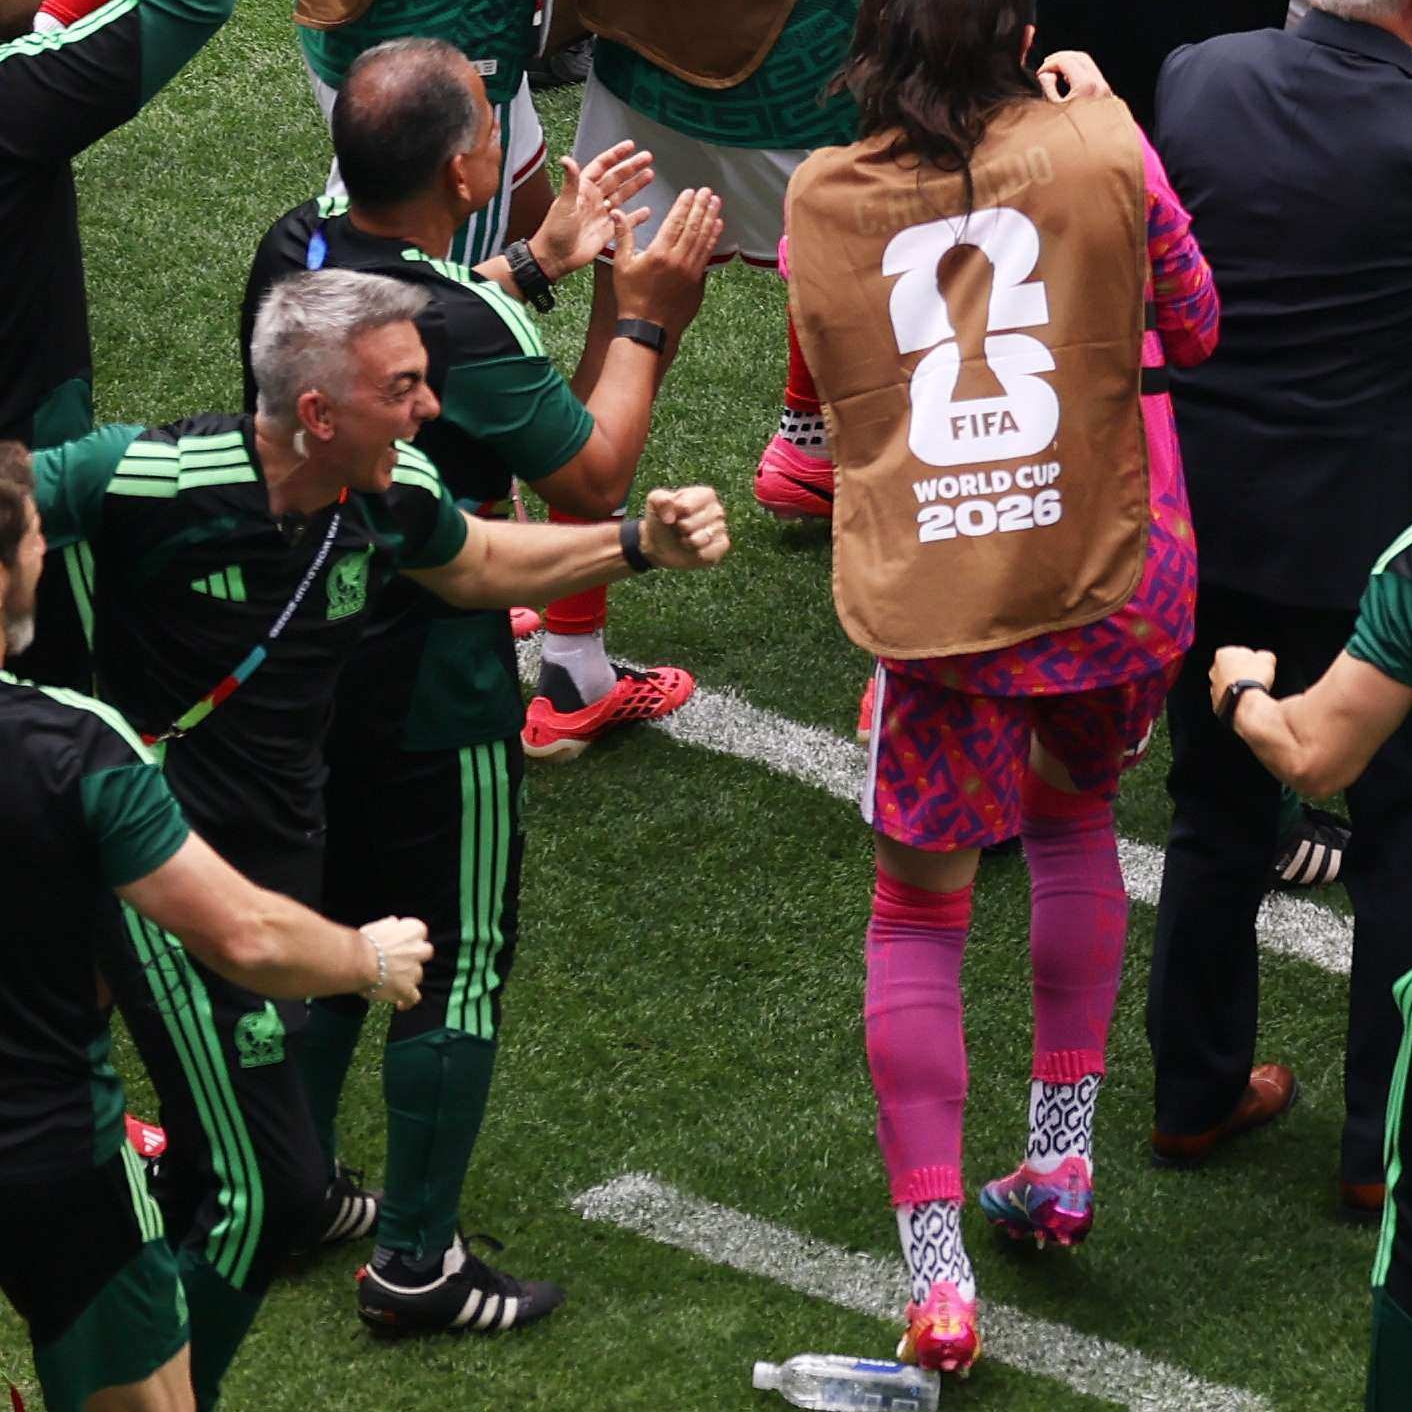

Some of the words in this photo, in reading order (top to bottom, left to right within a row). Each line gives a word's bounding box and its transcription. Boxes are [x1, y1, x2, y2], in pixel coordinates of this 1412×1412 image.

[950, 410, 1020, 441] FIFA
[912, 470, 1012, 503] WORLD
[1015, 462, 1061, 489] CUP
[917, 489, 1062, 543] 2026
